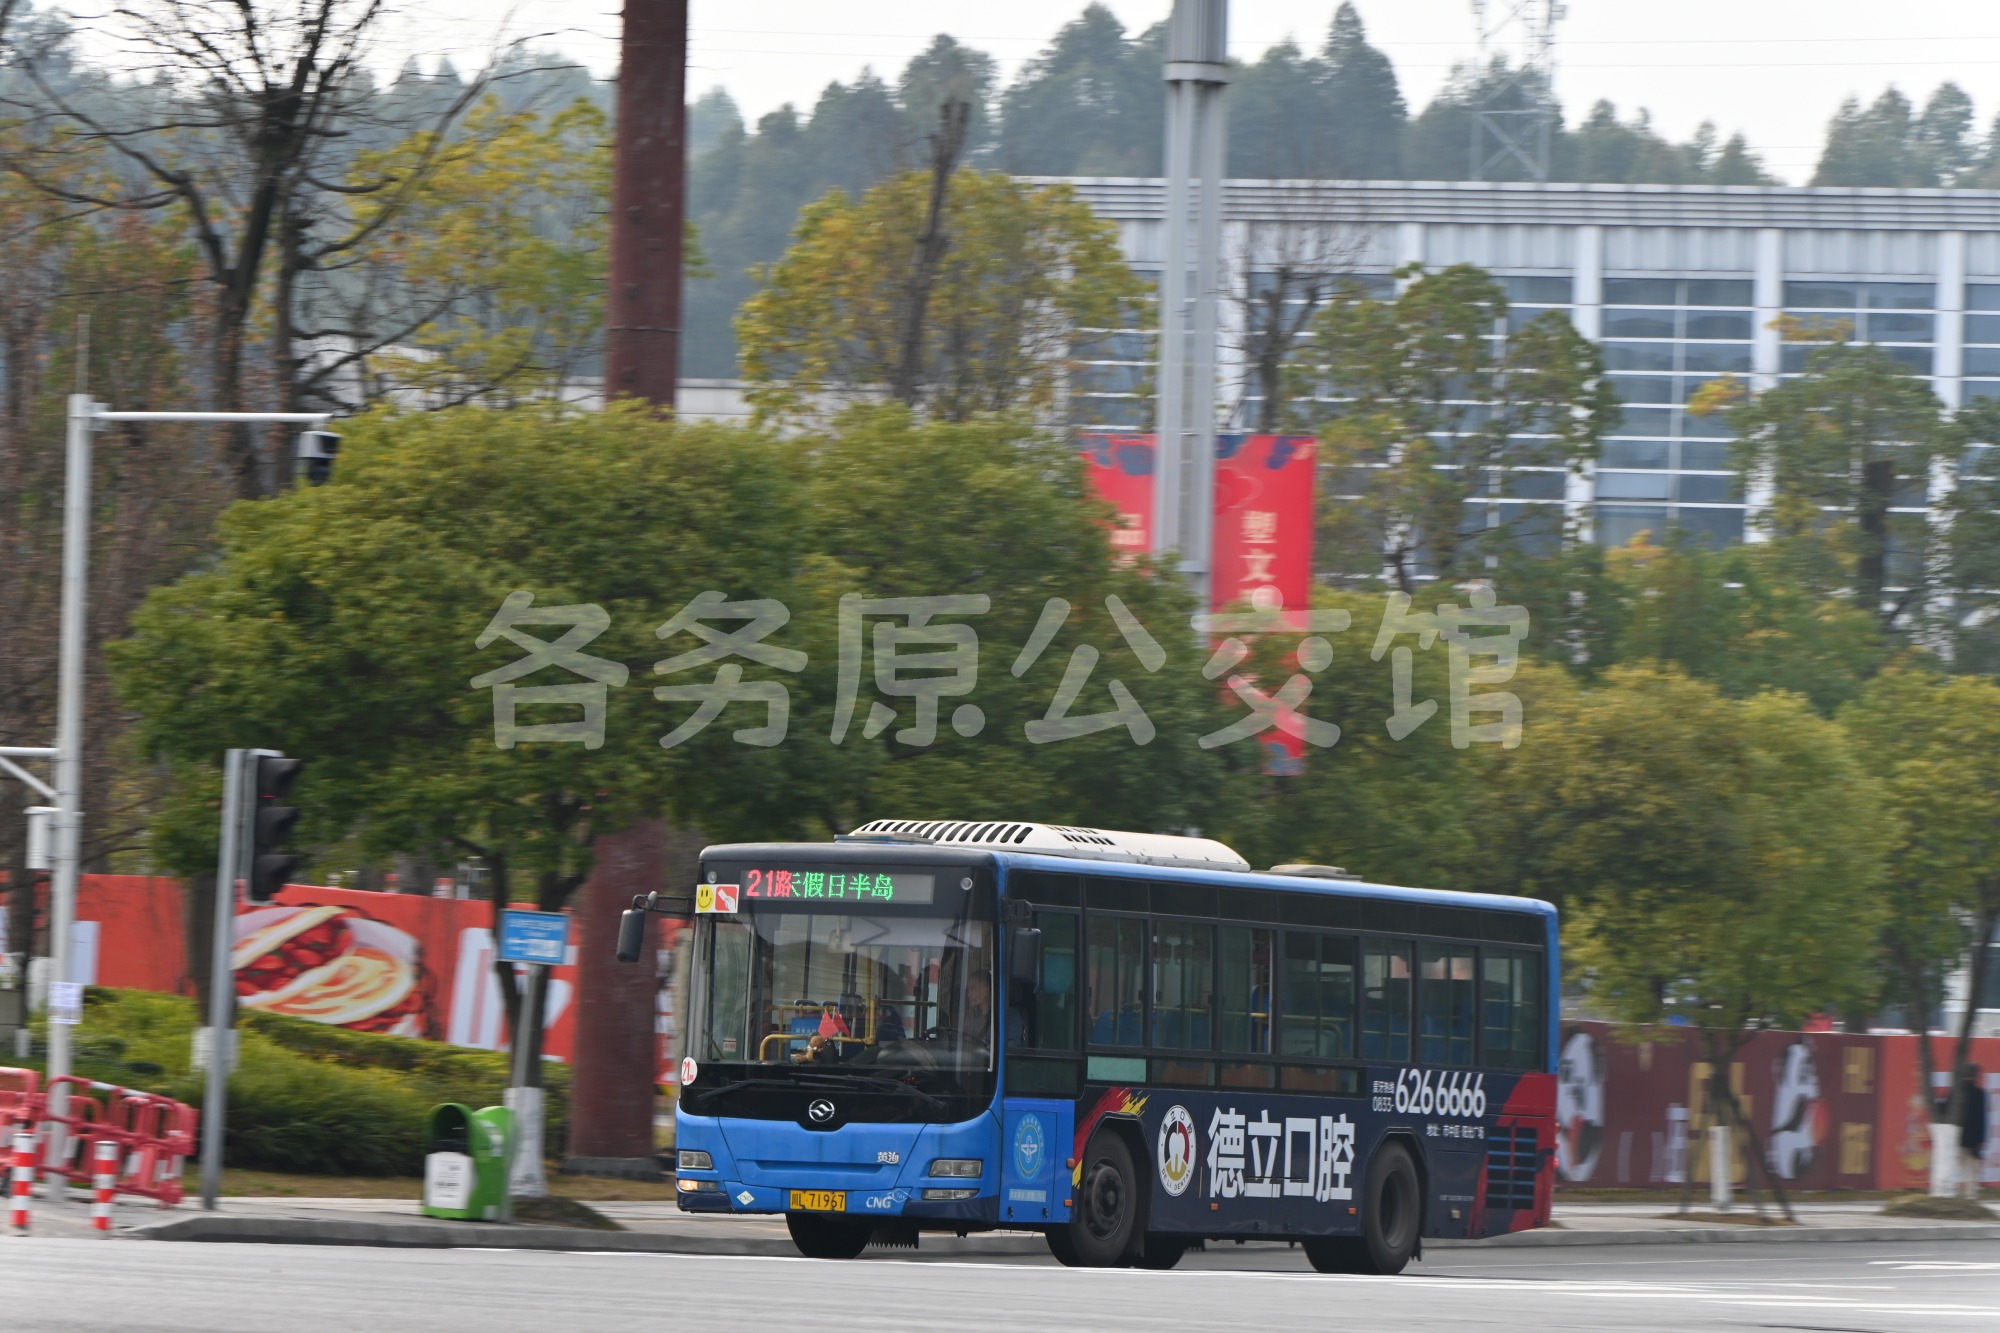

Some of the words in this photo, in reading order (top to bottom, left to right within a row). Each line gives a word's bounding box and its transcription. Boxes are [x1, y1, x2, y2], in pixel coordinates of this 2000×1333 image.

[746, 869, 793, 898] 21路
[1207, 1106, 1355, 1202] 德立口腔
[865, 1196, 893, 1209] CNG
